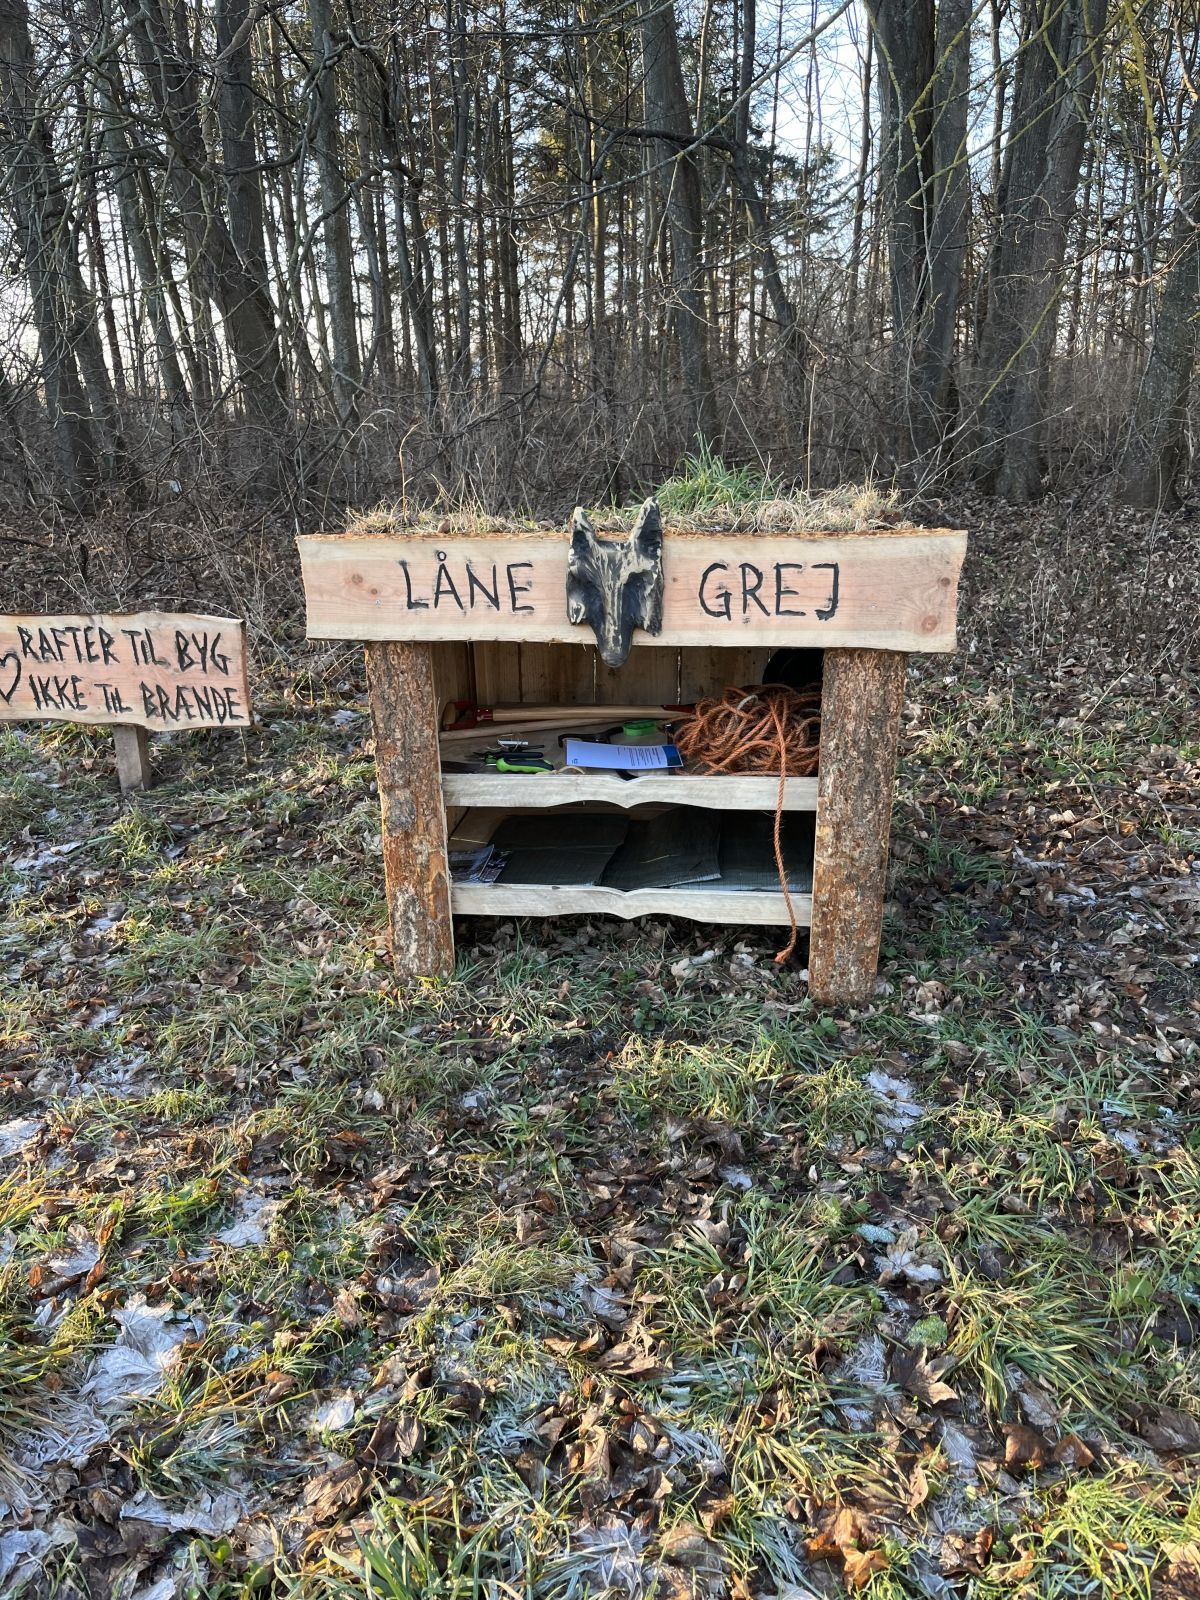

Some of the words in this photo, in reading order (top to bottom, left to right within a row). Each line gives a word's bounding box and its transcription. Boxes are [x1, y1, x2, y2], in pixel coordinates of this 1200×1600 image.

[399, 551, 535, 612] LÅNE
[699, 562, 839, 620] GREJ
[17, 626, 120, 665] RAFTER
[121, 628, 171, 666] TIL
[175, 630, 231, 675] BYG
[29, 674, 88, 711] IKKE
[94, 683, 133, 714] TIL
[139, 681, 244, 724] BRÆNDE
